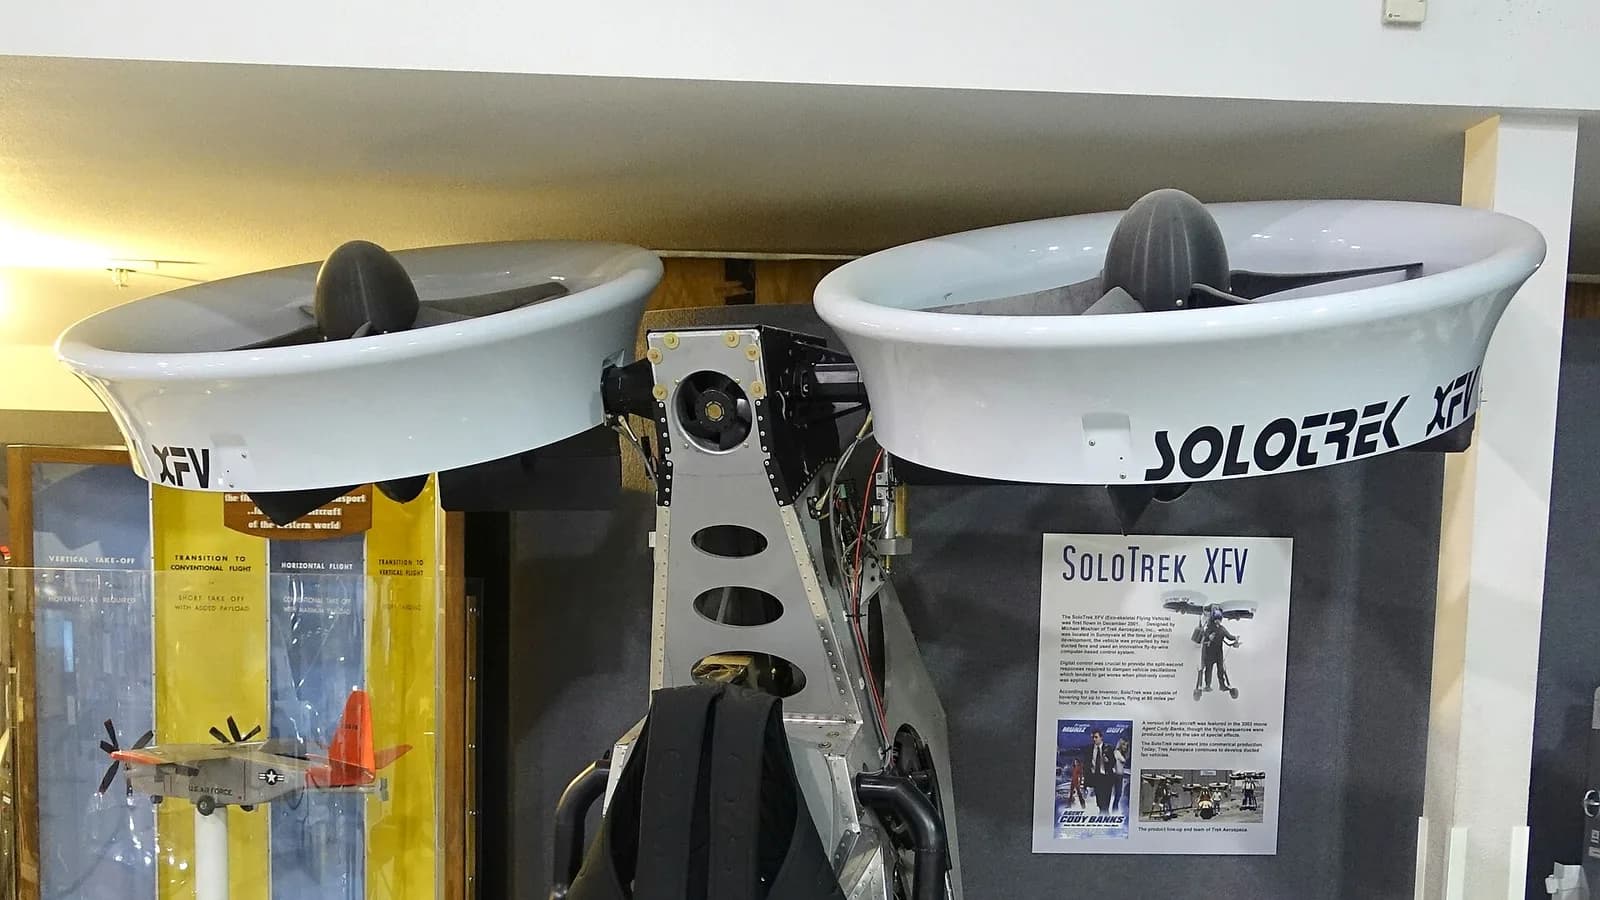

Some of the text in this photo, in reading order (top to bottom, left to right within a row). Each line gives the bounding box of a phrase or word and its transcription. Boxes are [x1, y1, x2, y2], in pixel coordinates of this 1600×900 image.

[1144, 365, 1480, 482] SOLOTREK XFV
[151, 444, 209, 488] XFV
[224, 494, 240, 502] the
[248, 520, 258, 528] of
[260, 520, 274, 528] the
[314, 521, 342, 530] world
[48, 556, 136, 564] VERTICAL TAKE-OFF
[175, 554, 228, 562] TRANSITION
[170, 564, 224, 572] CONVENTIONAL
[281, 562, 325, 570] HORIZONTAL
[1204, 547, 1249, 584] XFV
